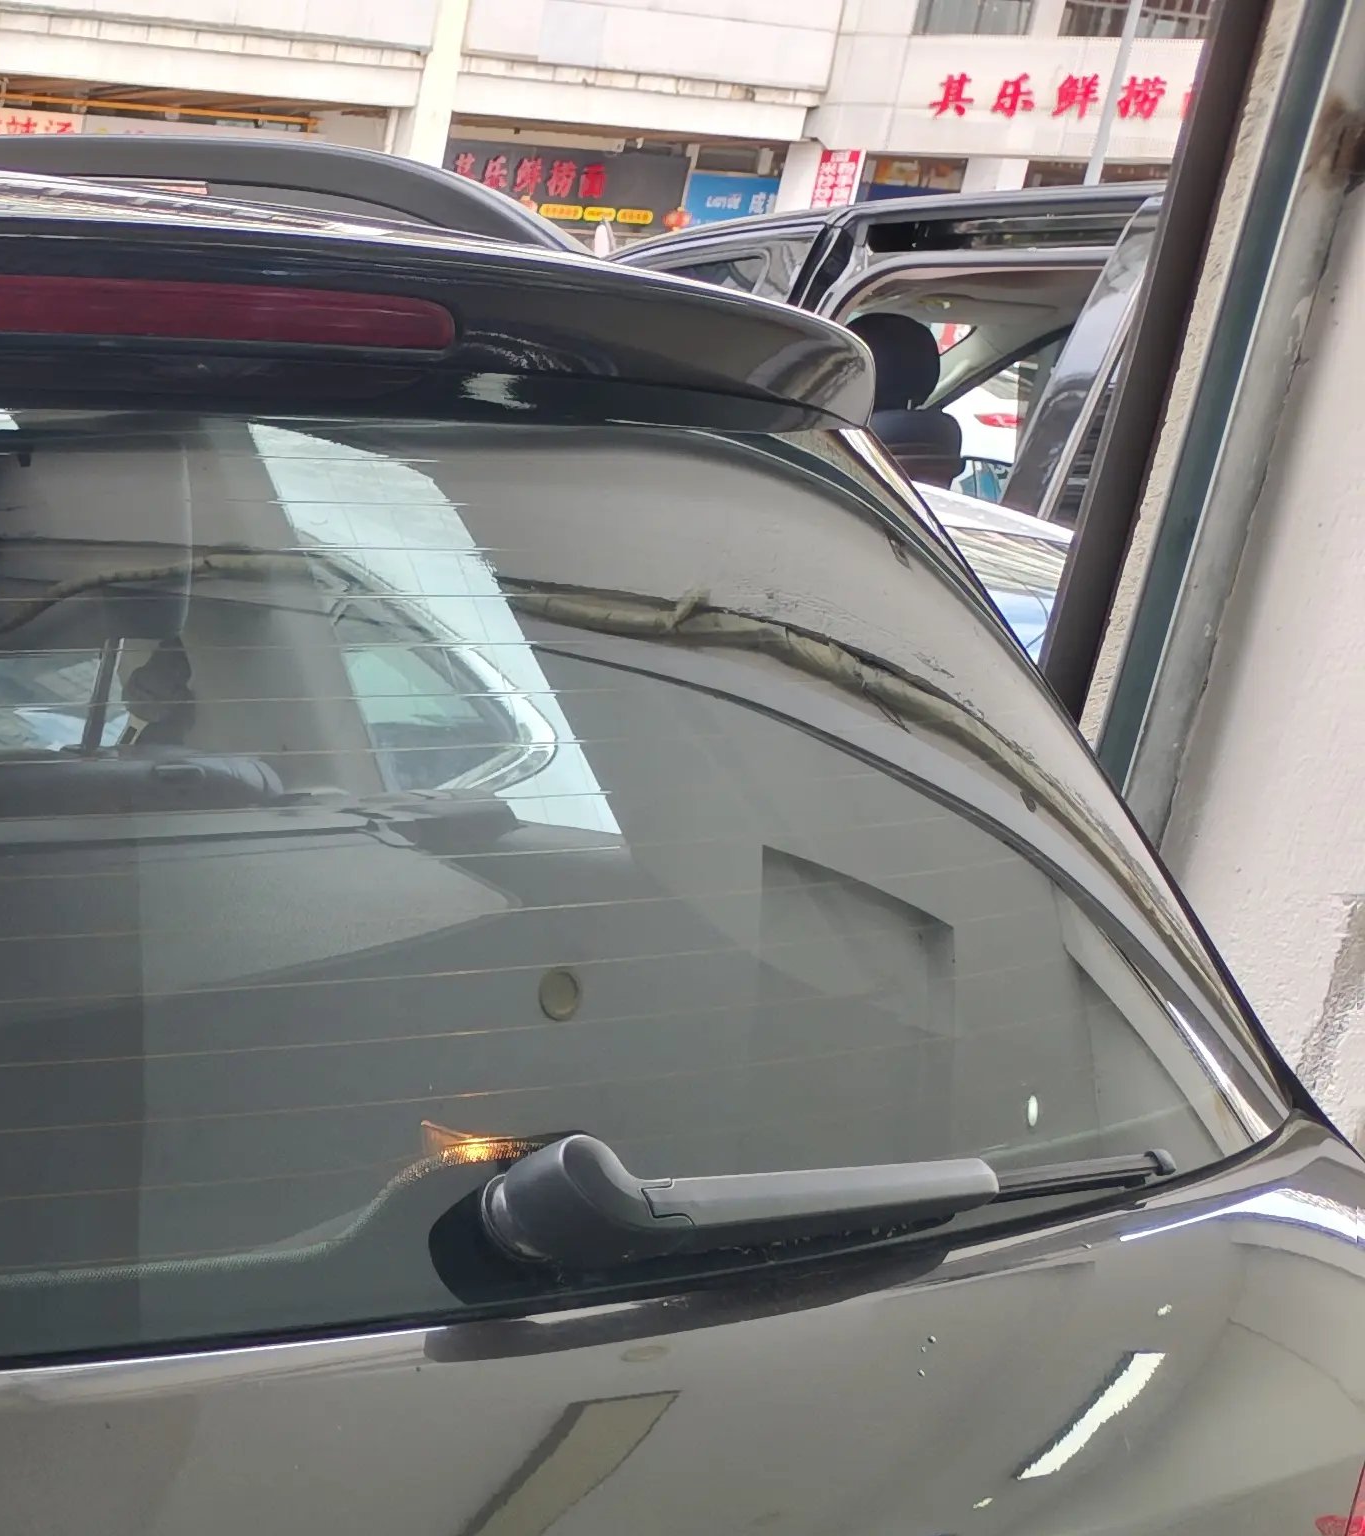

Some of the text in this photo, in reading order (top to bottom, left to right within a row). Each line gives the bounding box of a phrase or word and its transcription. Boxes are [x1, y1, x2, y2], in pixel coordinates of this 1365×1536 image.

[929, 73, 1194, 121] 其乐鲜捞
[453, 153, 607, 199] 其乐鲜捞面
